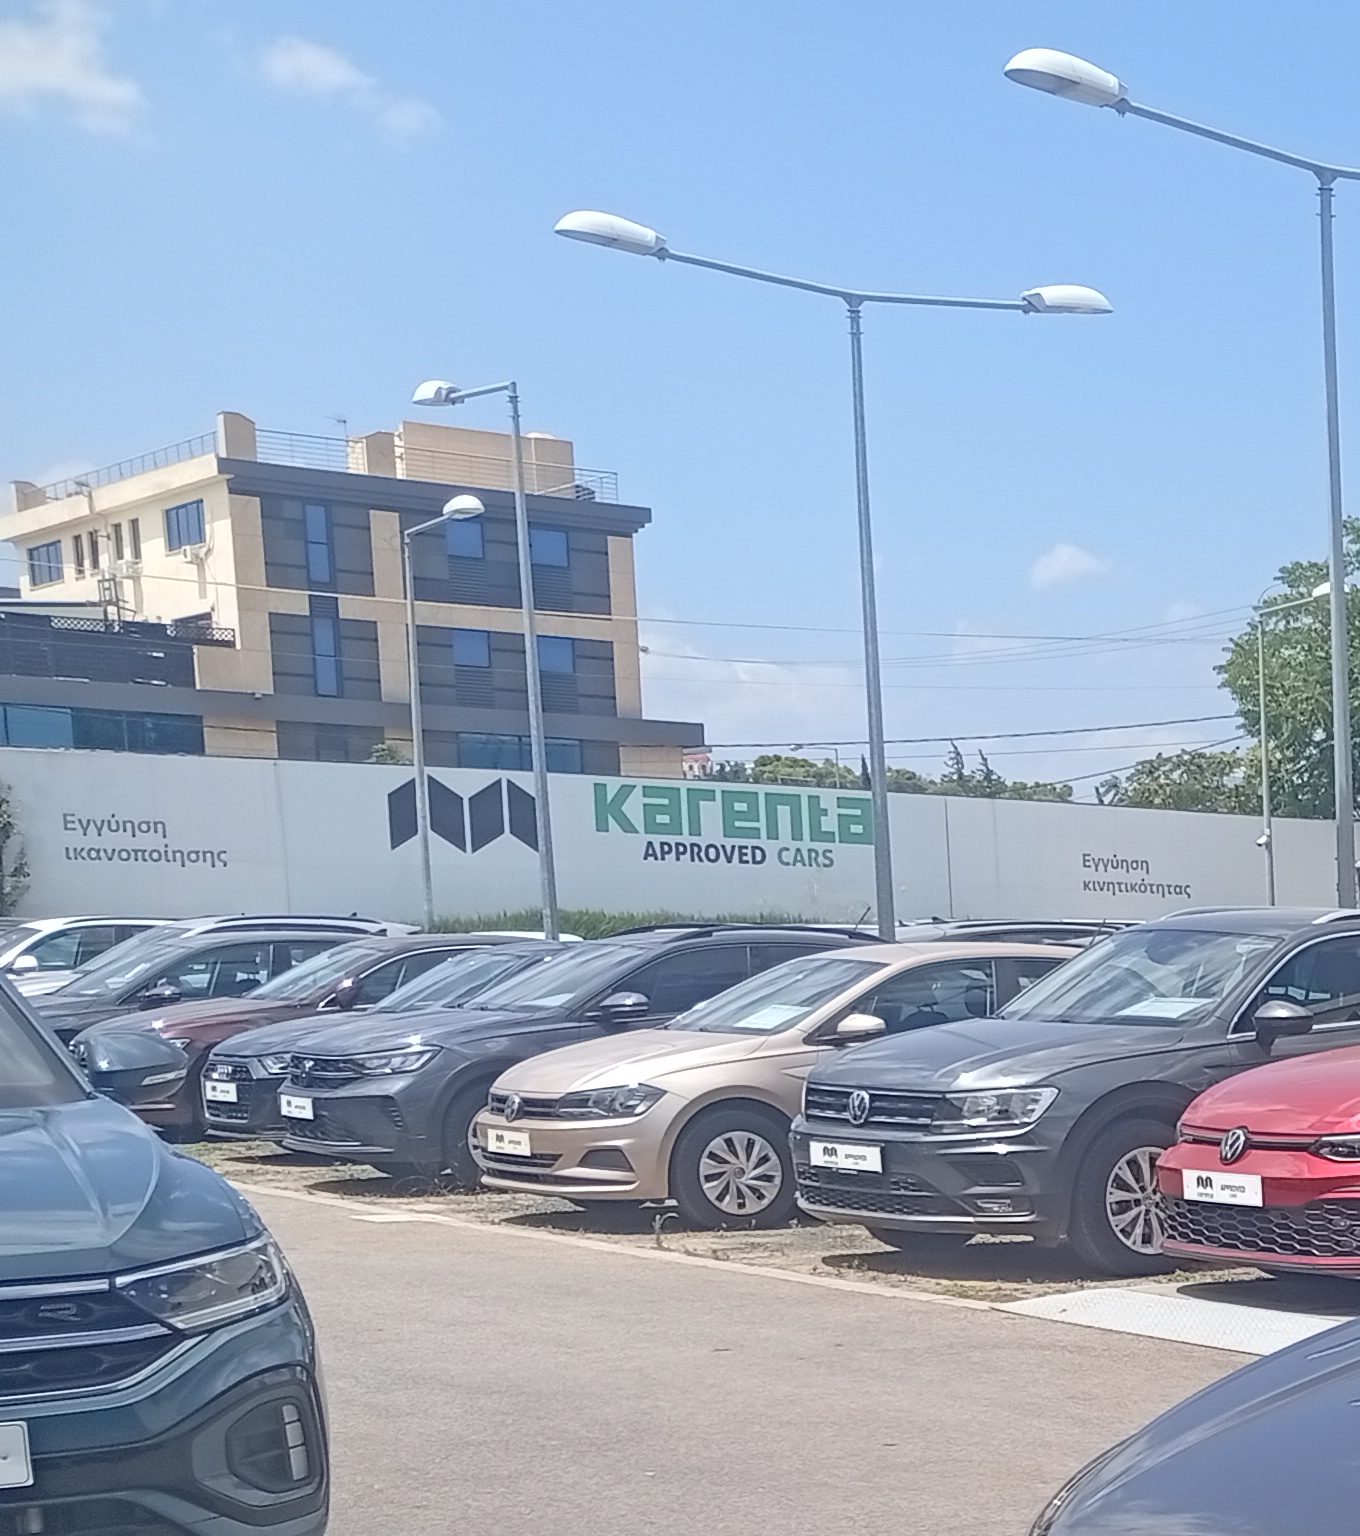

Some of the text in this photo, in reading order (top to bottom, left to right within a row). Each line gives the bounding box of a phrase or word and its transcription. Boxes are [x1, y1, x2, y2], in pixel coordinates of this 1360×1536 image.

[62, 813, 166, 839] Εγγύηση
[65, 844, 228, 868] ικανοποίησης
[643, 841, 835, 868] APPROVED CARS
[1082, 853, 1149, 875] Εγγύηση
[1083, 878, 1191, 899] κινητικότητας
